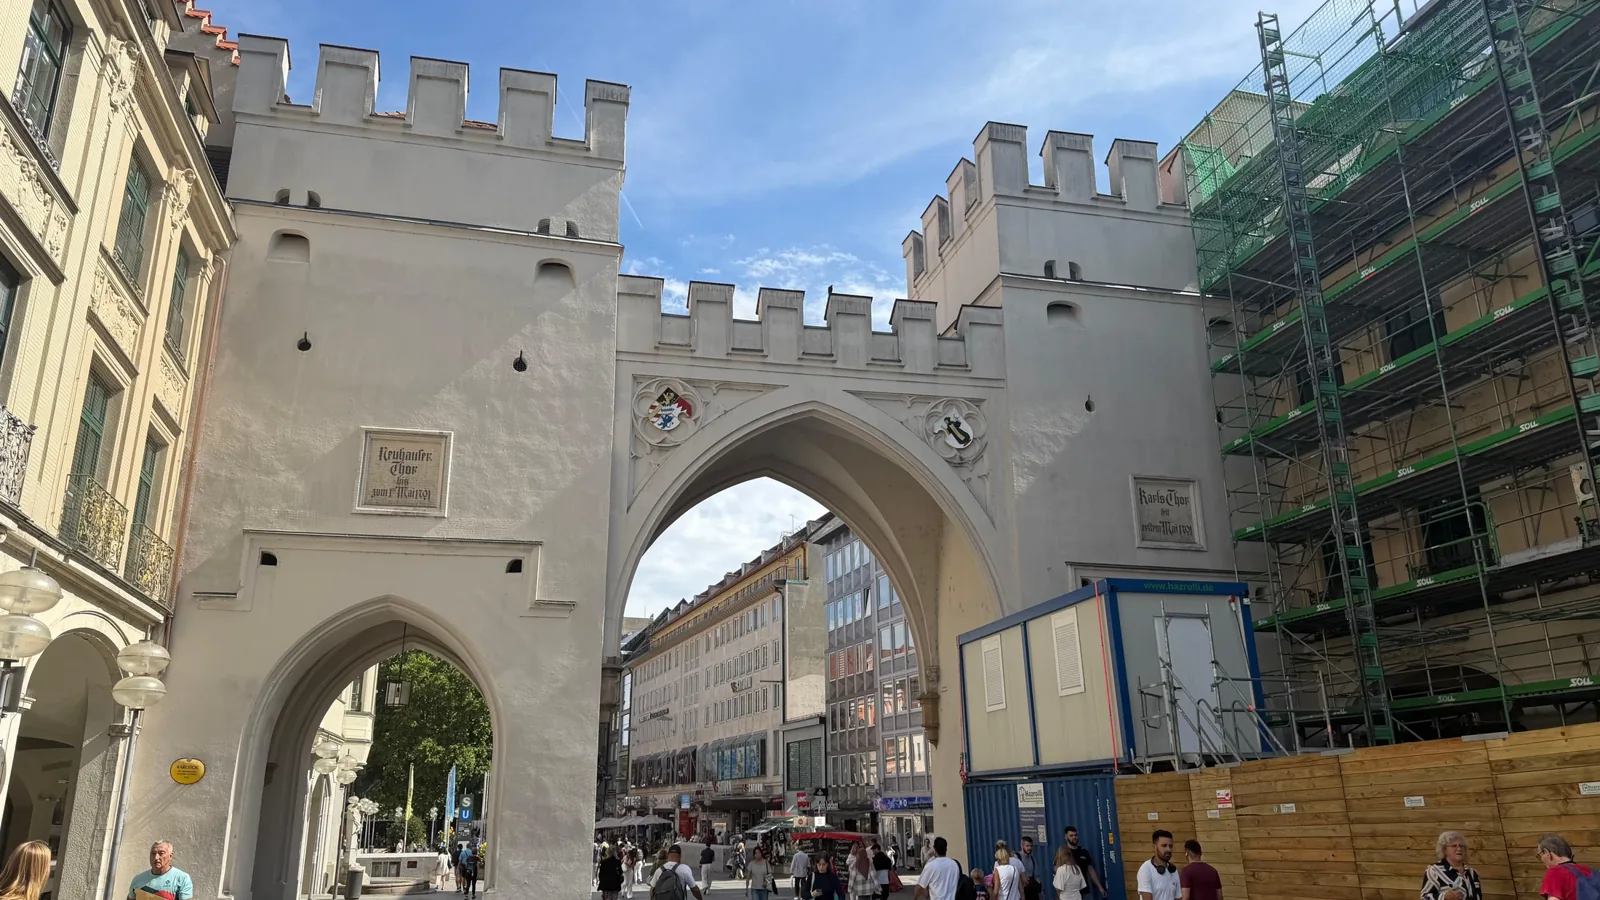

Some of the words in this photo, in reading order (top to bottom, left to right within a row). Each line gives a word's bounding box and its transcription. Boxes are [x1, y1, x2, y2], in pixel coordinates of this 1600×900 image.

[1450, 94, 1469, 108] SOLL
[1470, 196, 1489, 212] SOLL
[1360, 266, 1377, 278] SOLL
[1493, 304, 1515, 320] SOLL
[1272, 320, 1286, 331] SOLL
[1379, 363, 1396, 374] SOLL
[1287, 409, 1301, 419] SOLL
[1519, 421, 1540, 433] SOLL
[390, 461, 418, 477] Thor
[1397, 466, 1415, 478] SOLL
[396, 476, 409, 486] bis
[371, 488, 388, 498] zum
[395, 486, 415, 499] Mai
[415, 488, 431, 500] 1791
[1138, 487, 1165, 505] Karls
[1166, 489, 1190, 507] Thor
[1302, 504, 1316, 513] SOLL
[1159, 520, 1178, 535] Mai
[1178, 524, 1193, 536] 1791
[1143, 581, 1214, 592] www.hazrolli.de
[1416, 577, 1435, 587] SOLL
[1316, 603, 1331, 612] SOLL
[1569, 676, 1594, 687] SOLL
[1437, 695, 1456, 703] SOLL
[748, 783, 763, 793] SATURN
[462, 797, 471, 807] S
[462, 809, 470, 819] U
